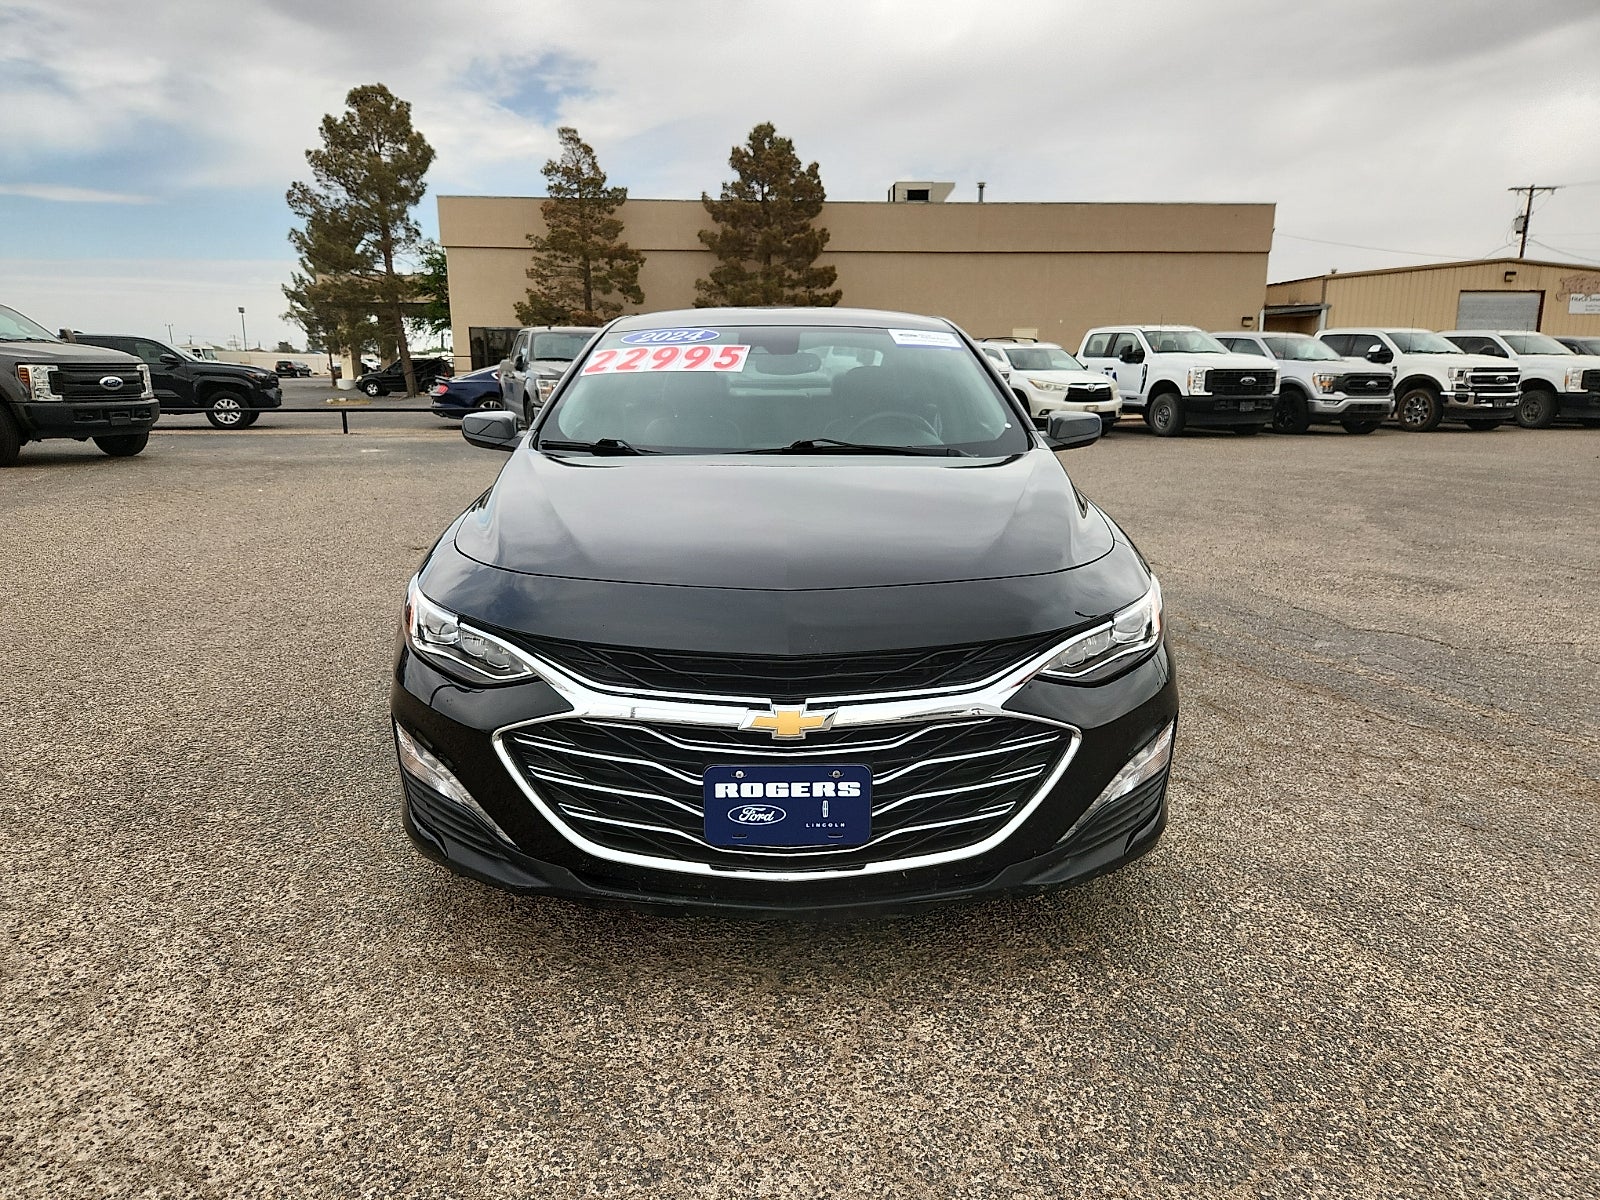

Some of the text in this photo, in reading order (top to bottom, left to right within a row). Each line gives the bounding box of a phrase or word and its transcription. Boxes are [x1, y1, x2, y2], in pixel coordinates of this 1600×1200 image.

[636, 330, 702, 343] 2024
[584, 346, 745, 373] 22995
[714, 782, 861, 799] ROGERS
[738, 805, 775, 823] Ford
